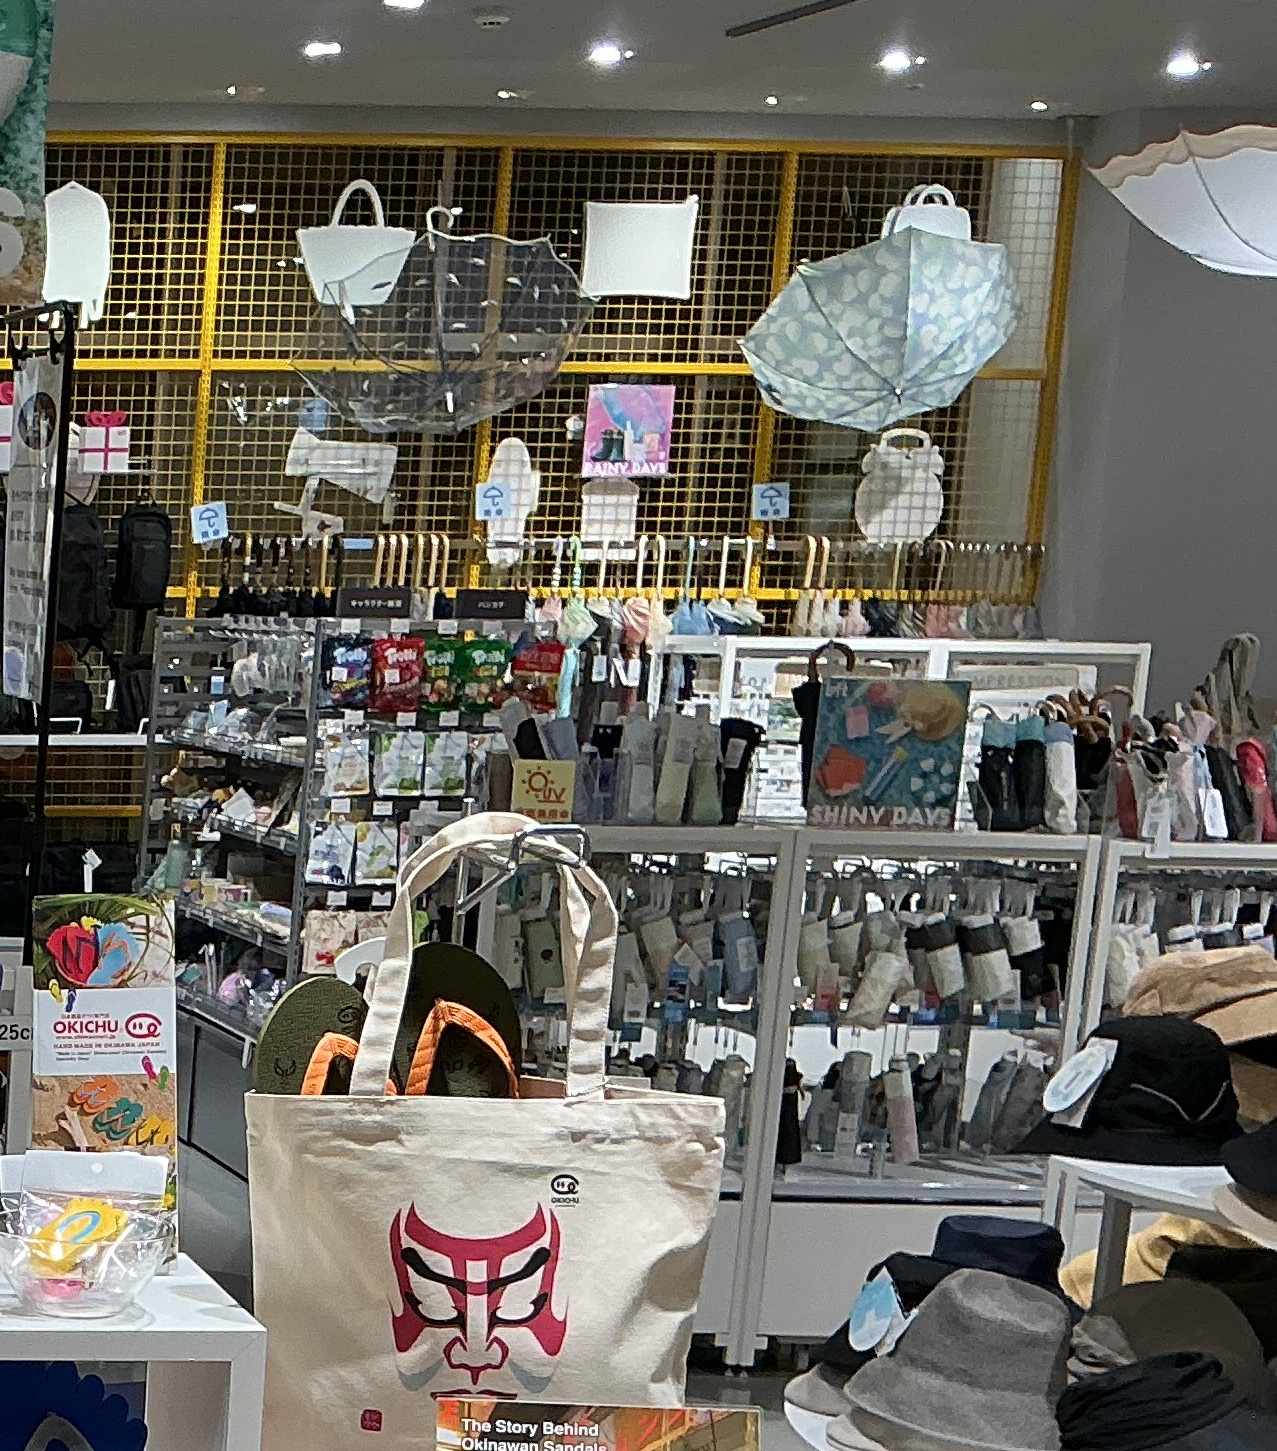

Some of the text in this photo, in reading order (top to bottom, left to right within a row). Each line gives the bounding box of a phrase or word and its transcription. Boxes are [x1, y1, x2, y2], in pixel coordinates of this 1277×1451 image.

[542, 787, 567, 800] UV
[808, 804, 953, 827] SHINY DAYS
[53, 1020, 119, 1034] OKICHU
[461, 1418, 600, 1438] The Story Behind
